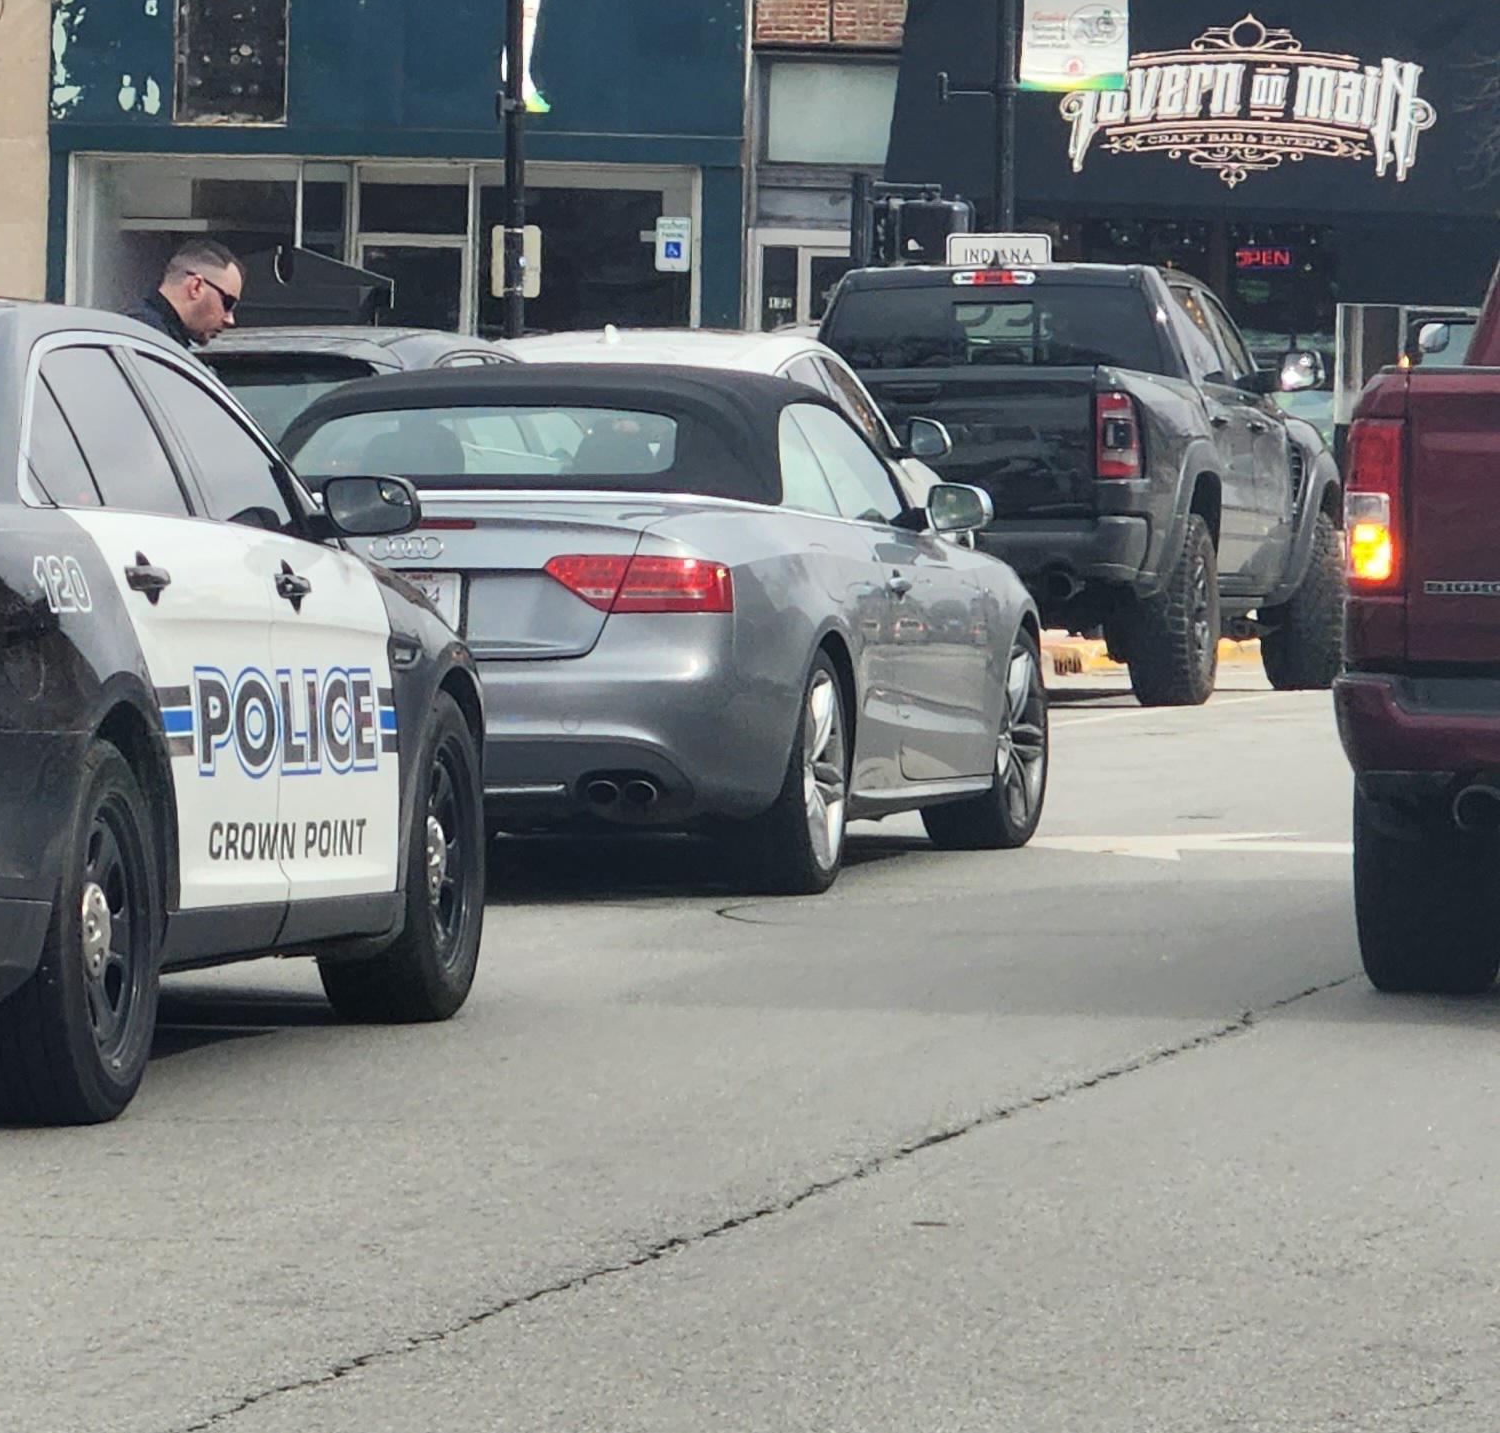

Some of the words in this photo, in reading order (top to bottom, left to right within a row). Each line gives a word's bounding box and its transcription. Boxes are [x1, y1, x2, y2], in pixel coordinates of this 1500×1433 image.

[1147, 133, 1204, 144] CRAFT
[1208, 133, 1243, 143] BAR
[1245, 133, 1257, 143] &
[1262, 135, 1330, 149] EATERY
[1236, 251, 1291, 266] OPEN
[33, 555, 92, 613] 120
[193, 665, 379, 779] POLICE
[209, 821, 295, 860] CROWN
[304, 818, 366, 859] POINT
